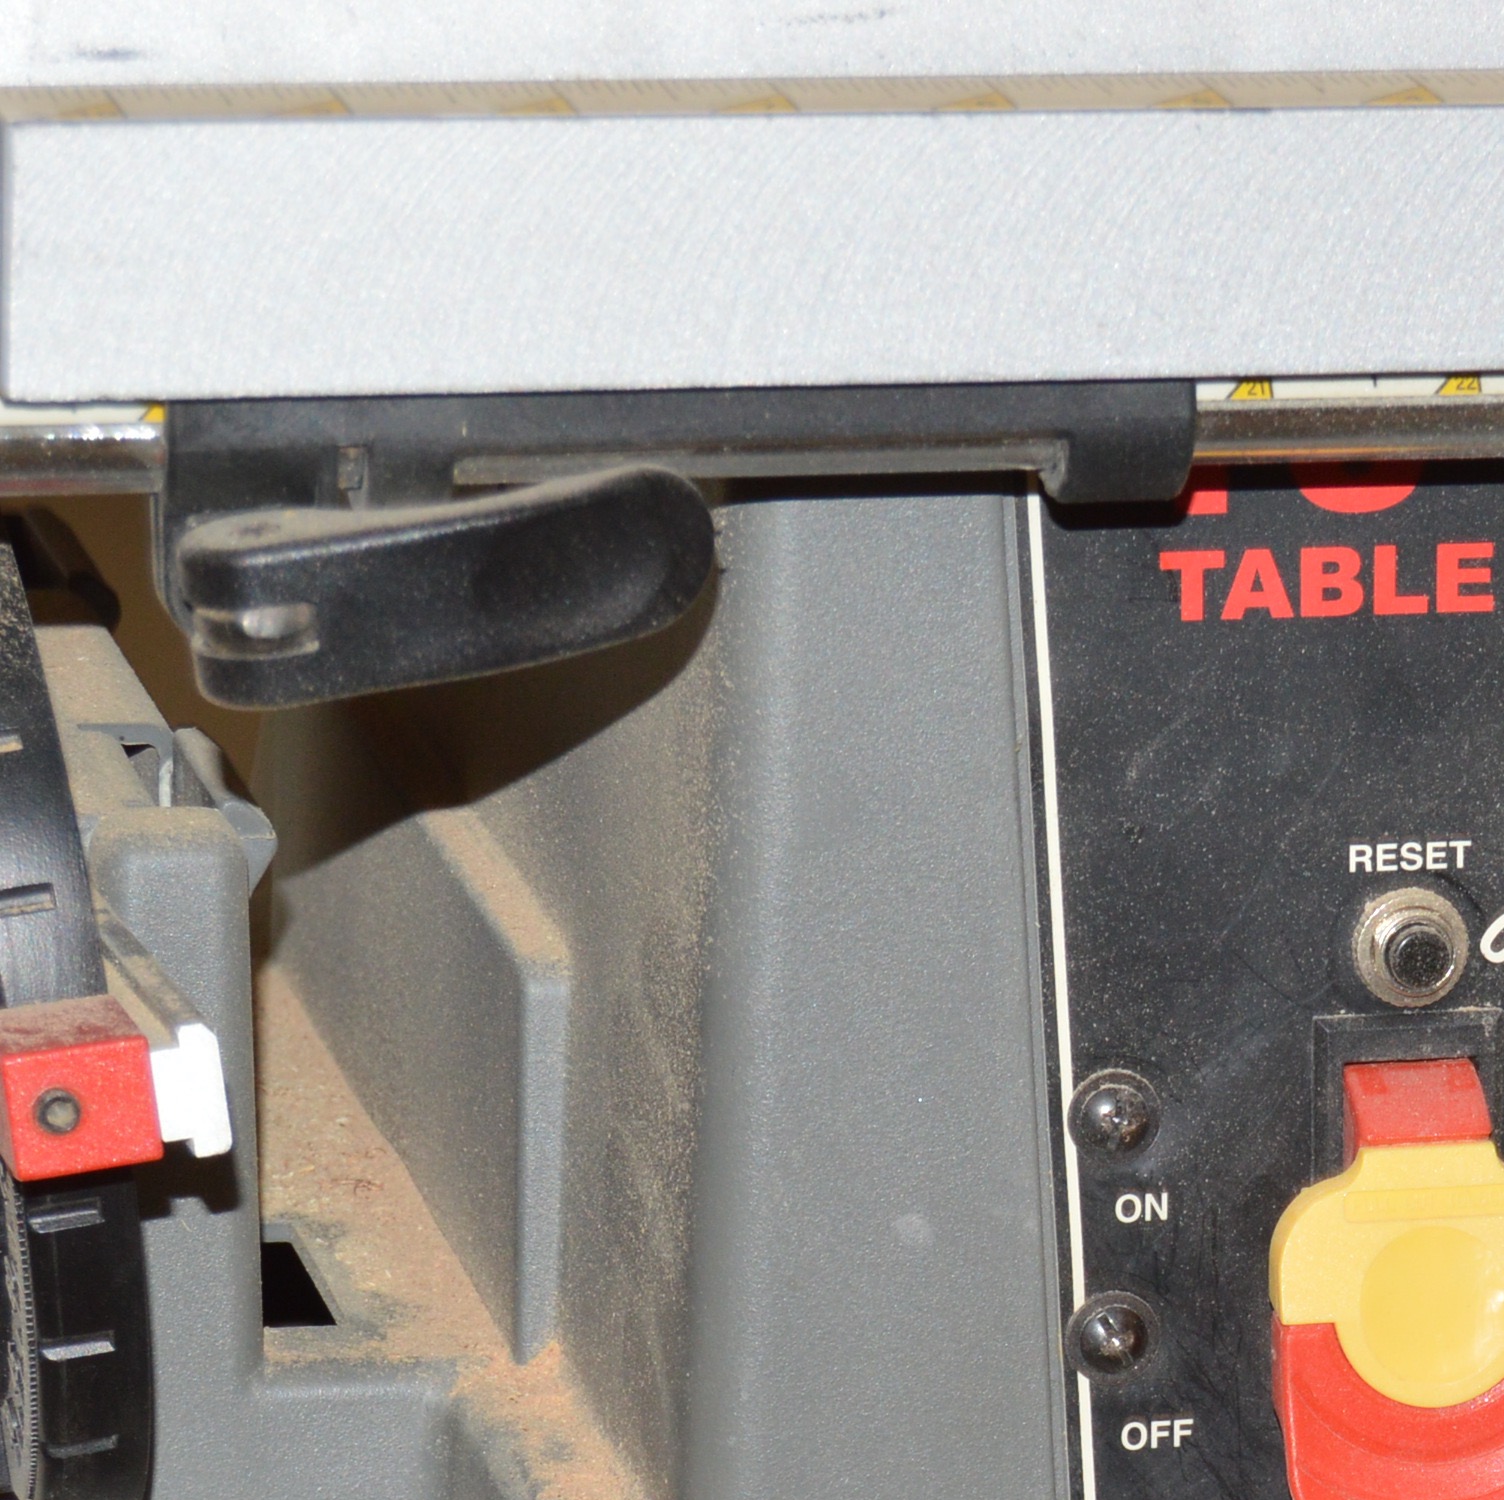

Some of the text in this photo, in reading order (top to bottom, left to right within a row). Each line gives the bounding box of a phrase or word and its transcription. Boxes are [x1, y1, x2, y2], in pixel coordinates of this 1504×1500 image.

[1160, 541, 1494, 622] TABLE
[1349, 840, 1471, 872] RESET
[1114, 1193, 1169, 1223] ON
[1121, 1419, 1193, 1451] OFF
